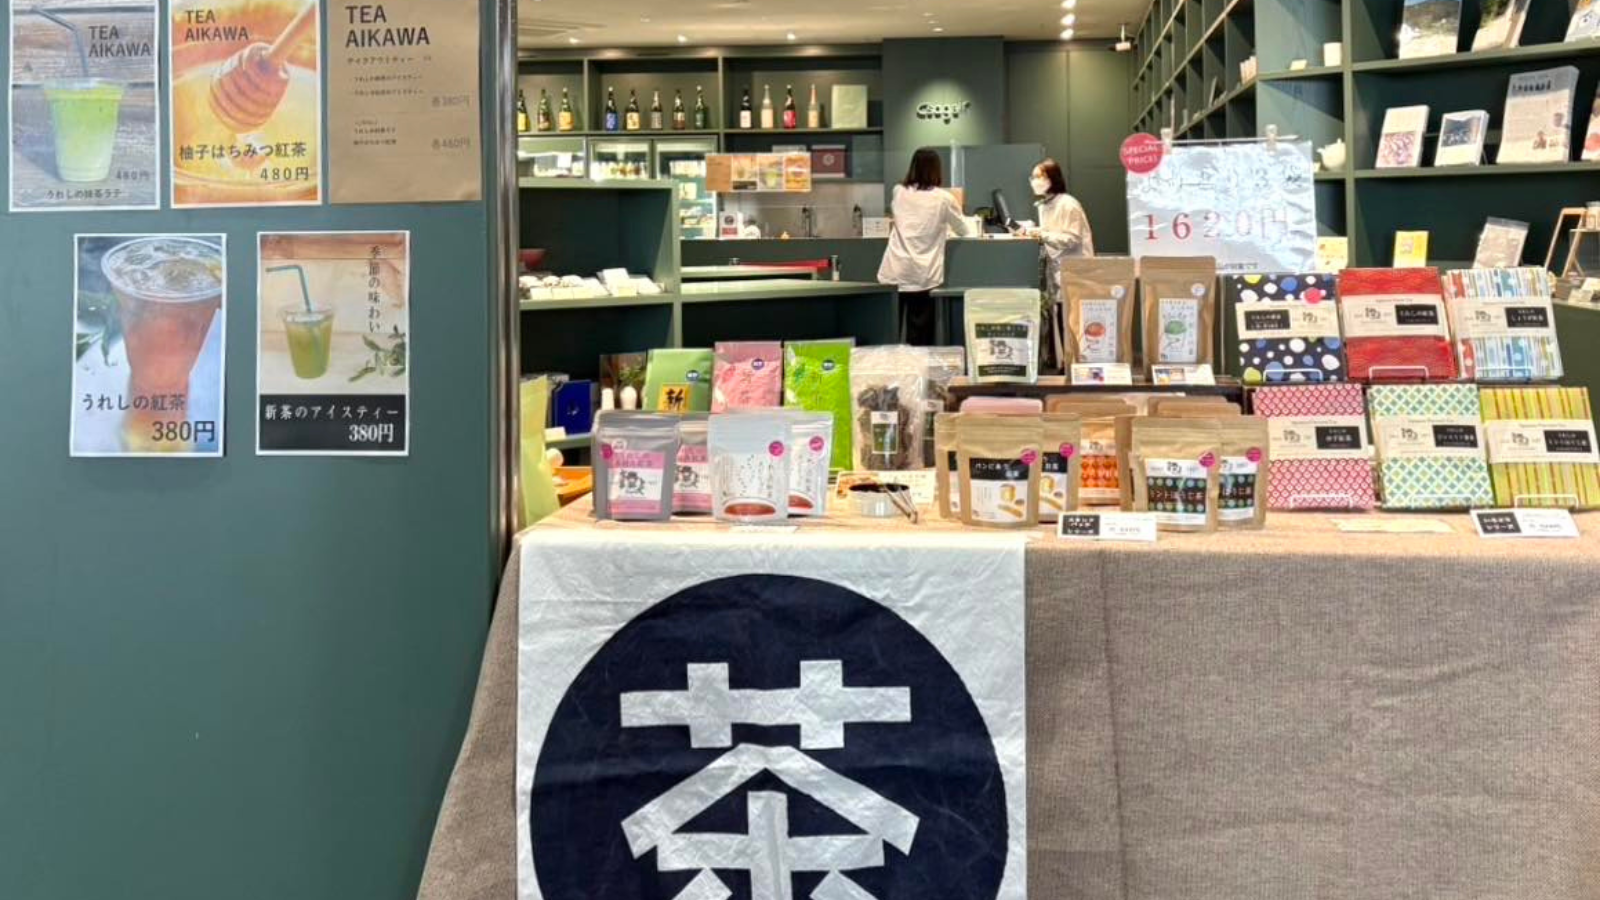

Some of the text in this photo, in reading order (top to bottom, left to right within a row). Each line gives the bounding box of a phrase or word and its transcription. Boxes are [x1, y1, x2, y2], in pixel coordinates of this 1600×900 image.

[185, 10, 216, 24] TEA
[345, 5, 387, 24] TEA
[88, 25, 119, 40] TEA
[185, 26, 249, 42] AIKAWA
[345, 27, 430, 48] AIKAWA
[88, 42, 151, 57] AIKAWA
[179, 142, 307, 161] 柚子はちみつ紅茶
[1121, 143, 1159, 156] SPECIAL
[260, 166, 309, 181] 480円
[46, 188, 121, 200] うれしの抹茶ラテ
[1144, 205, 1288, 240] 1620円
[367, 245, 381, 333] 季節の味わい
[83, 393, 186, 411] うれしの紅茶
[265, 404, 399, 421] 新茶のアイスティー
[152, 420, 216, 443] 380円
[349, 423, 394, 443] 380円
[619, 659, 921, 900] 茶
